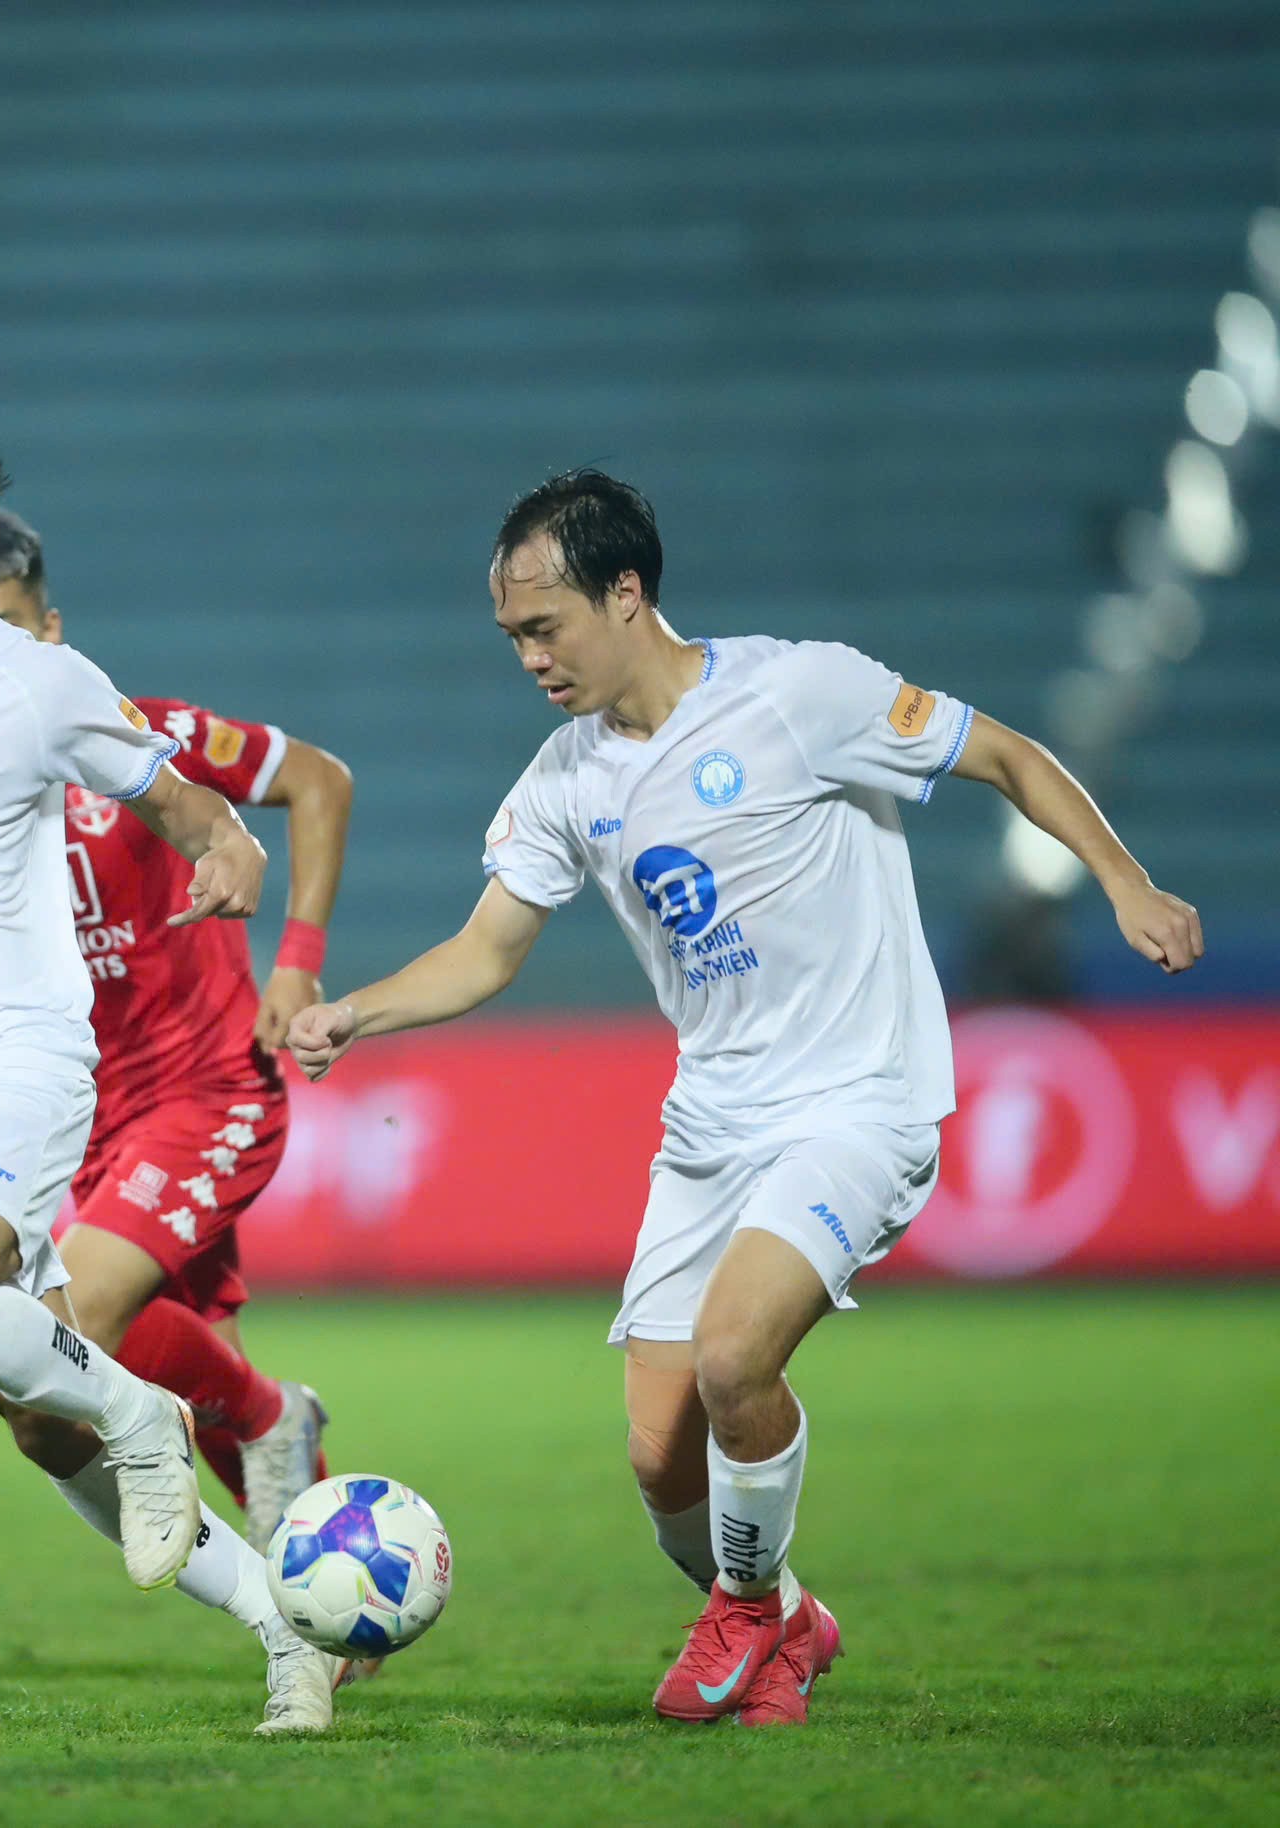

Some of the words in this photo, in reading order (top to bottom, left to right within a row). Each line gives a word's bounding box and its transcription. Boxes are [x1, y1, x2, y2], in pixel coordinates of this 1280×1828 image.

[901, 689, 924, 728] LPBan
[589, 817, 622, 838] Mitre
[77, 920, 136, 955] ION
[808, 1203, 852, 1253] Mitre
